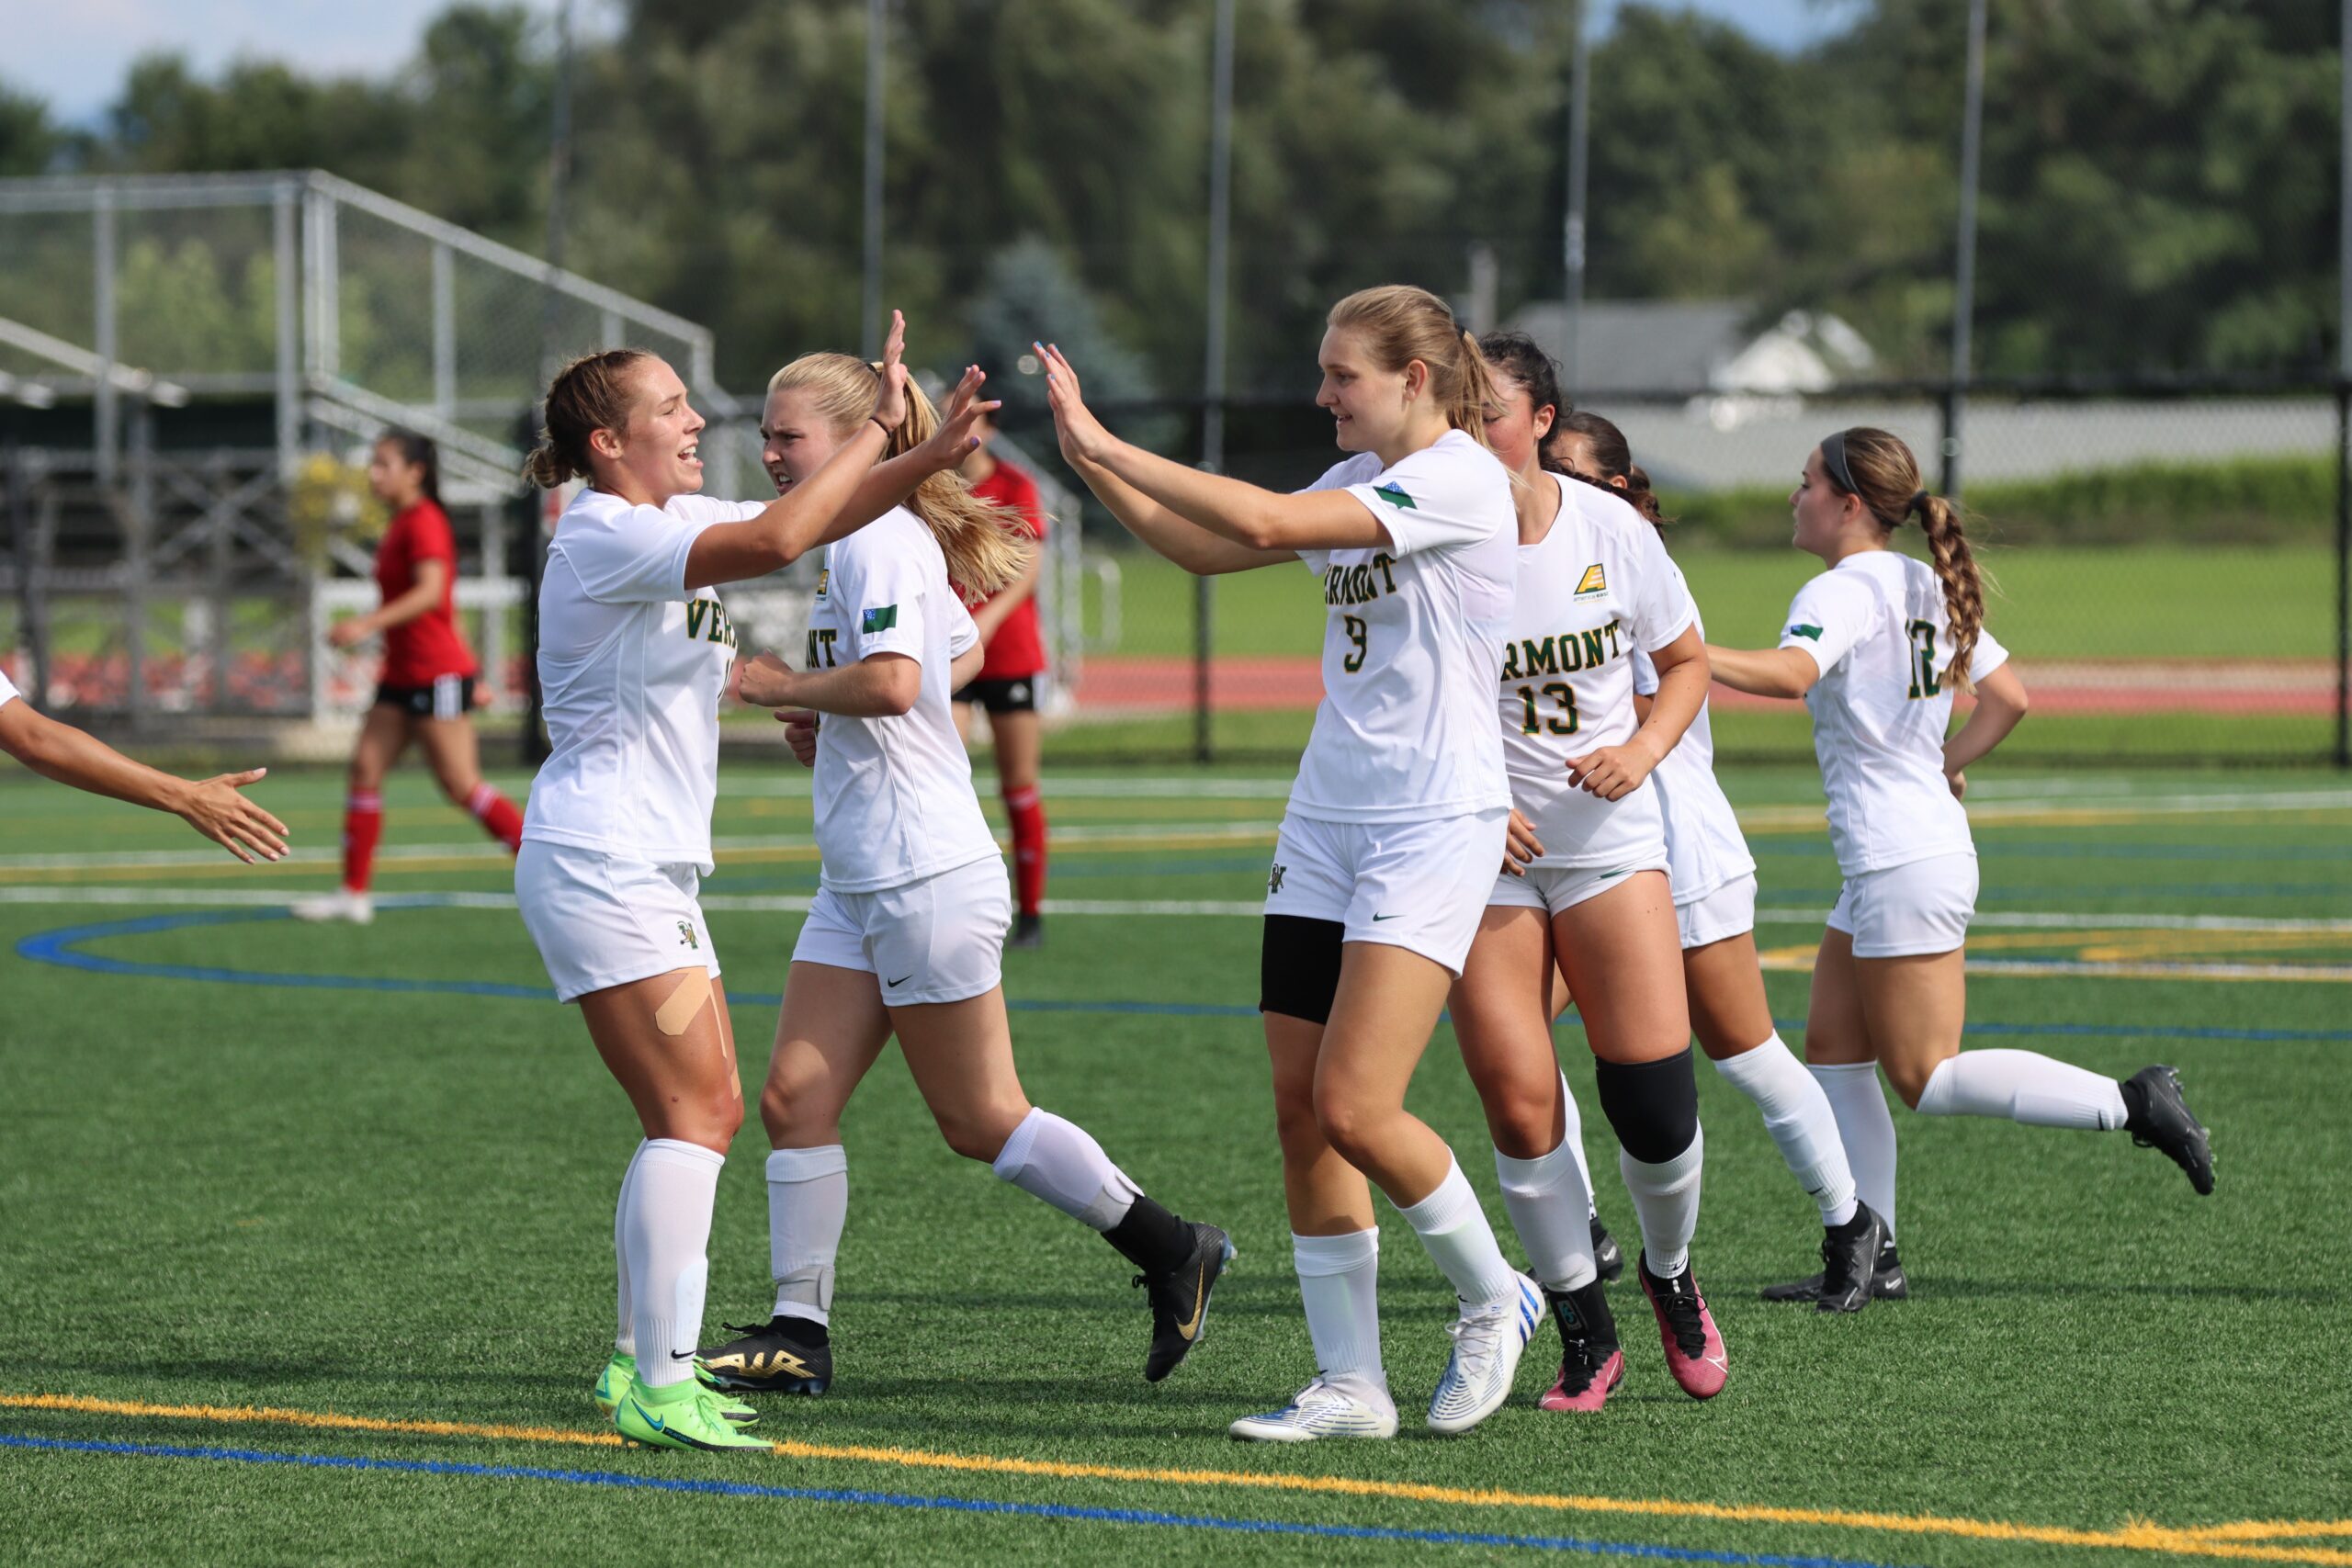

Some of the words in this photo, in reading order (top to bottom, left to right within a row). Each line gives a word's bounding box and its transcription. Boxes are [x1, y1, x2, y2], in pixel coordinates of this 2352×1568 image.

[1343, 614, 1367, 674] 9
[1501, 619, 1621, 682] RMONT
[1905, 617, 1946, 699] 12
[1517, 682, 1578, 735] 13
[700, 1349, 817, 1378] AIR
